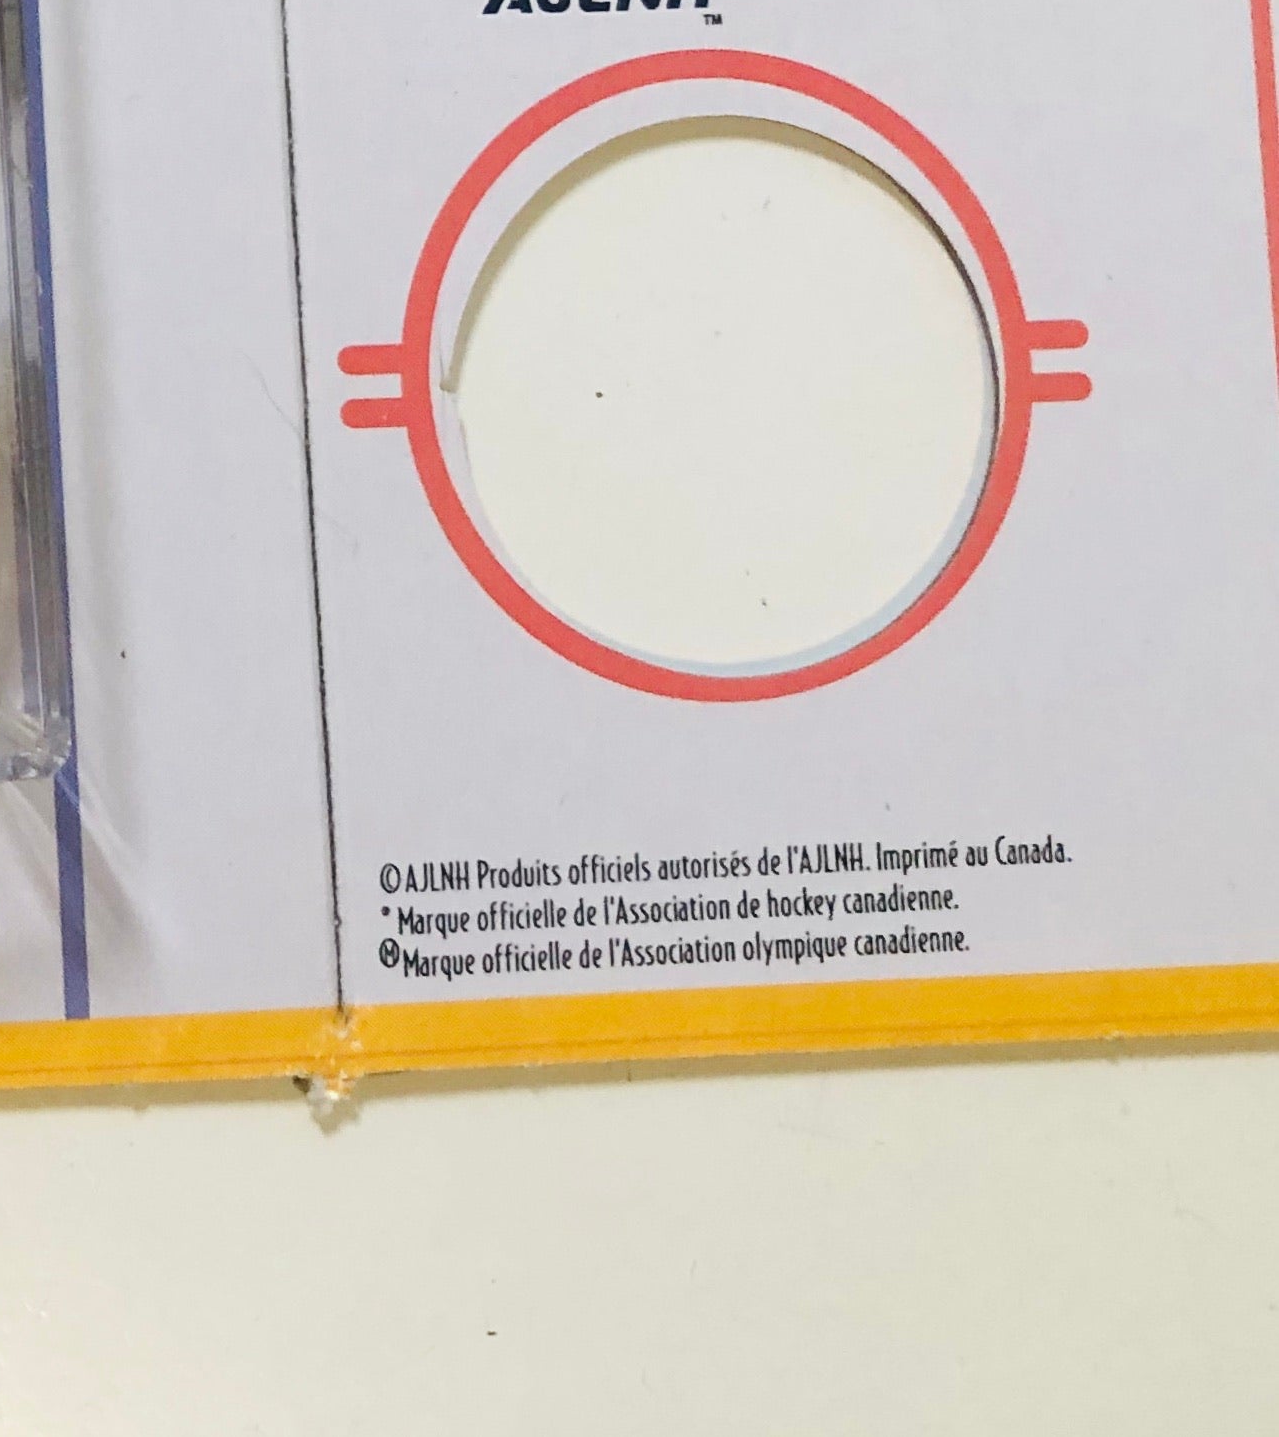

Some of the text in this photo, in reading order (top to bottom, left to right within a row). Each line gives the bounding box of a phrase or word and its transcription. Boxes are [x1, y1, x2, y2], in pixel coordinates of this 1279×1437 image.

[476, 857, 562, 890] Produits
[568, 851, 652, 885] officiels
[657, 849, 752, 882] autorisés
[757, 846, 782, 877] de
[787, 841, 871, 876] l'AJLNH.
[876, 840, 959, 876] Imprimé
[965, 845, 989, 868] au
[995, 834, 1073, 865] Canada.
[397, 883, 960, 940] Marque officielle de l'Association de hockey canadienne.
[481, 939, 573, 974] officielle
[579, 939, 603, 969] de
[608, 935, 737, 968] l'Association
[742, 931, 847, 966] olympique
[854, 925, 970, 956] canadienne.
